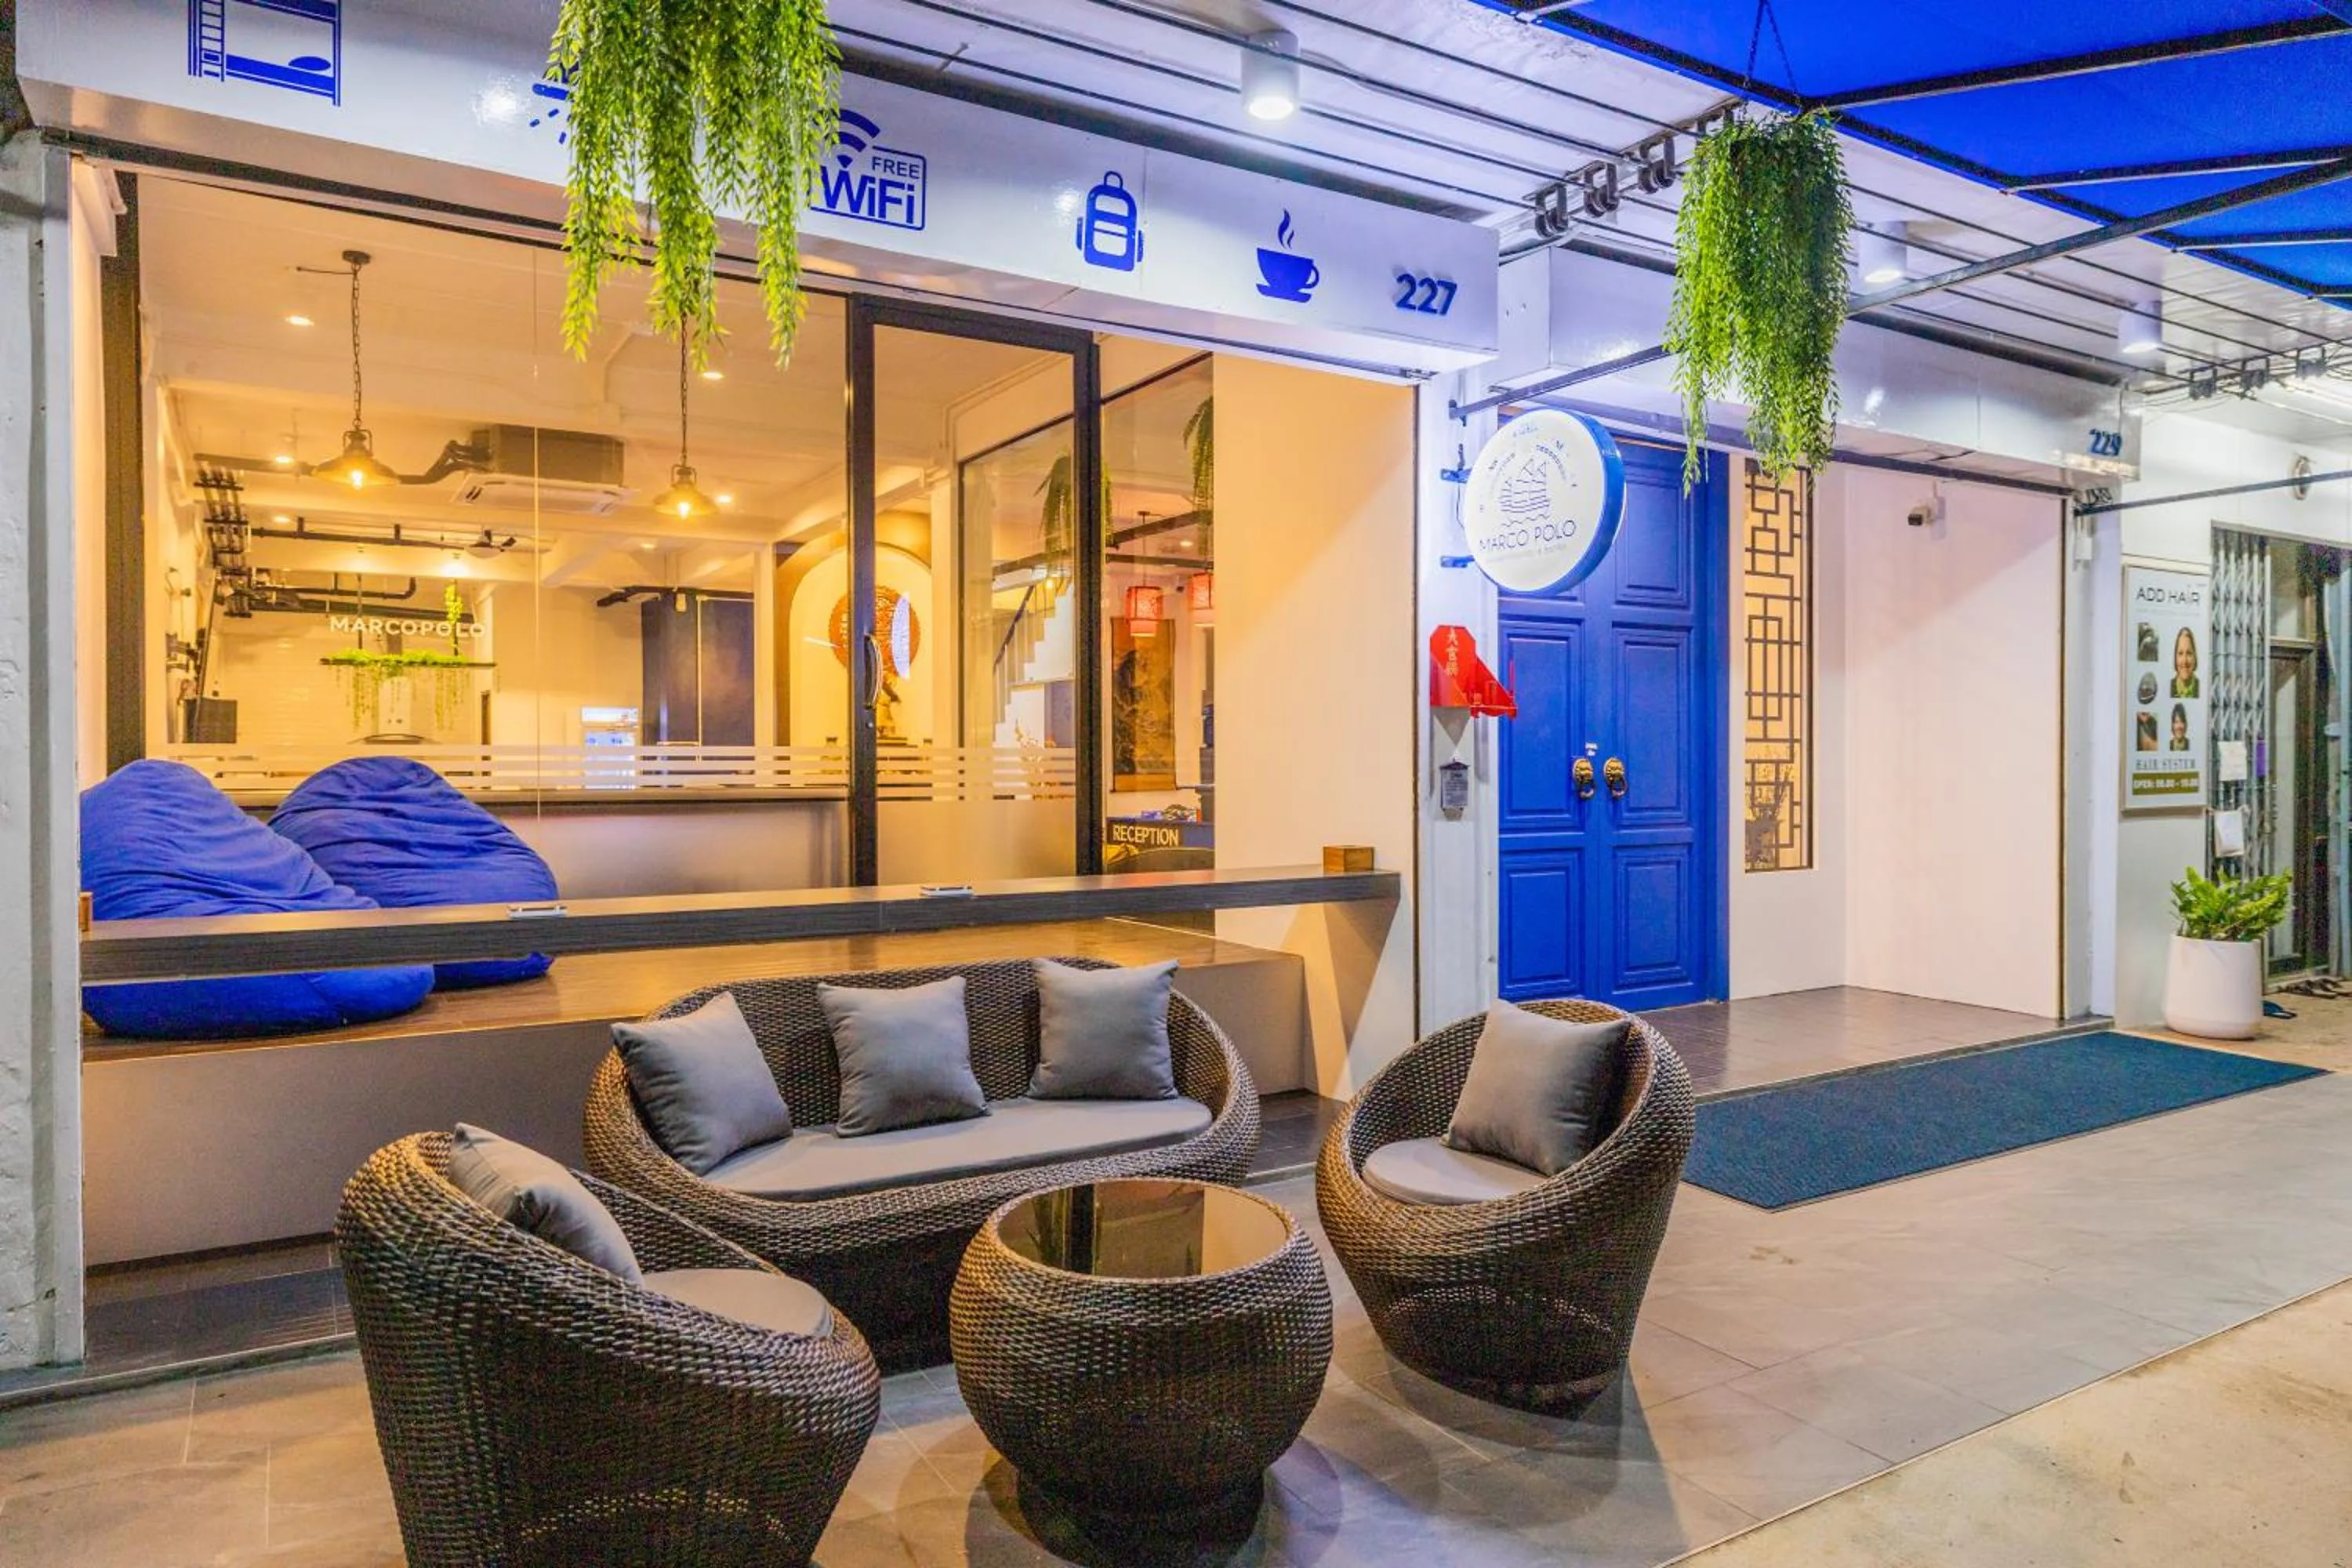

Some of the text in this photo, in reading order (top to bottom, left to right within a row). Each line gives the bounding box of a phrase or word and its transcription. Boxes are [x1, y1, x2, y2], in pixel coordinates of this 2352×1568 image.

[872, 156, 920, 180] FREE
[821, 165, 915, 224] WiFi
[1396, 273, 1457, 316] 227
[2089, 428, 2122, 456] 229
[1479, 529, 1529, 550] MARCO
[1534, 520, 1577, 543] POLO
[2136, 586, 2200, 605] ADD HAIR
[2136, 757, 2195, 770] HAIR SYSTEM
[1113, 824, 1179, 847] RECEPTION
